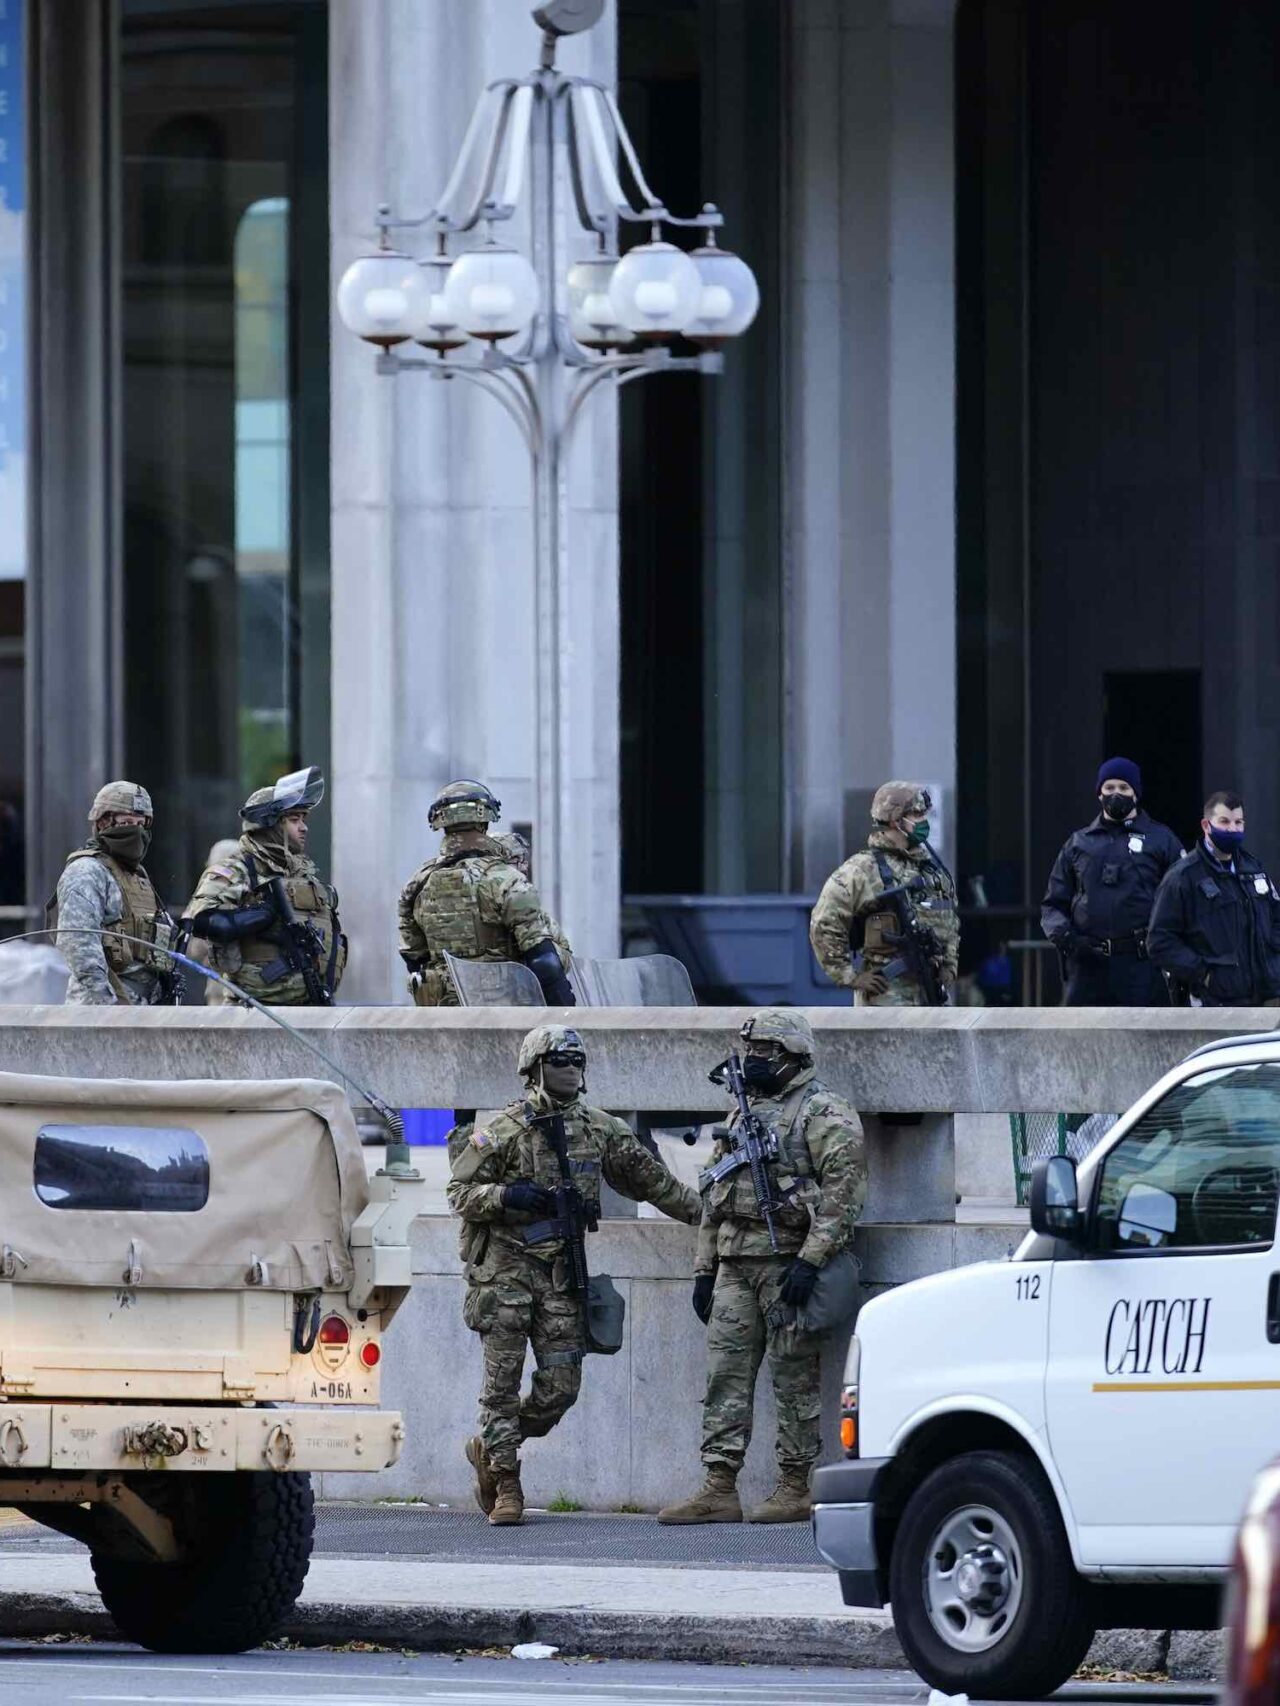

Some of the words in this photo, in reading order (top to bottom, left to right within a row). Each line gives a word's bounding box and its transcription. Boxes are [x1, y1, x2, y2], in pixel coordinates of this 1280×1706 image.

[1015, 1274, 1041, 1301] 112
[1103, 1297, 1212, 1377] CATCH
[310, 1381, 353, 1399] A-06A
